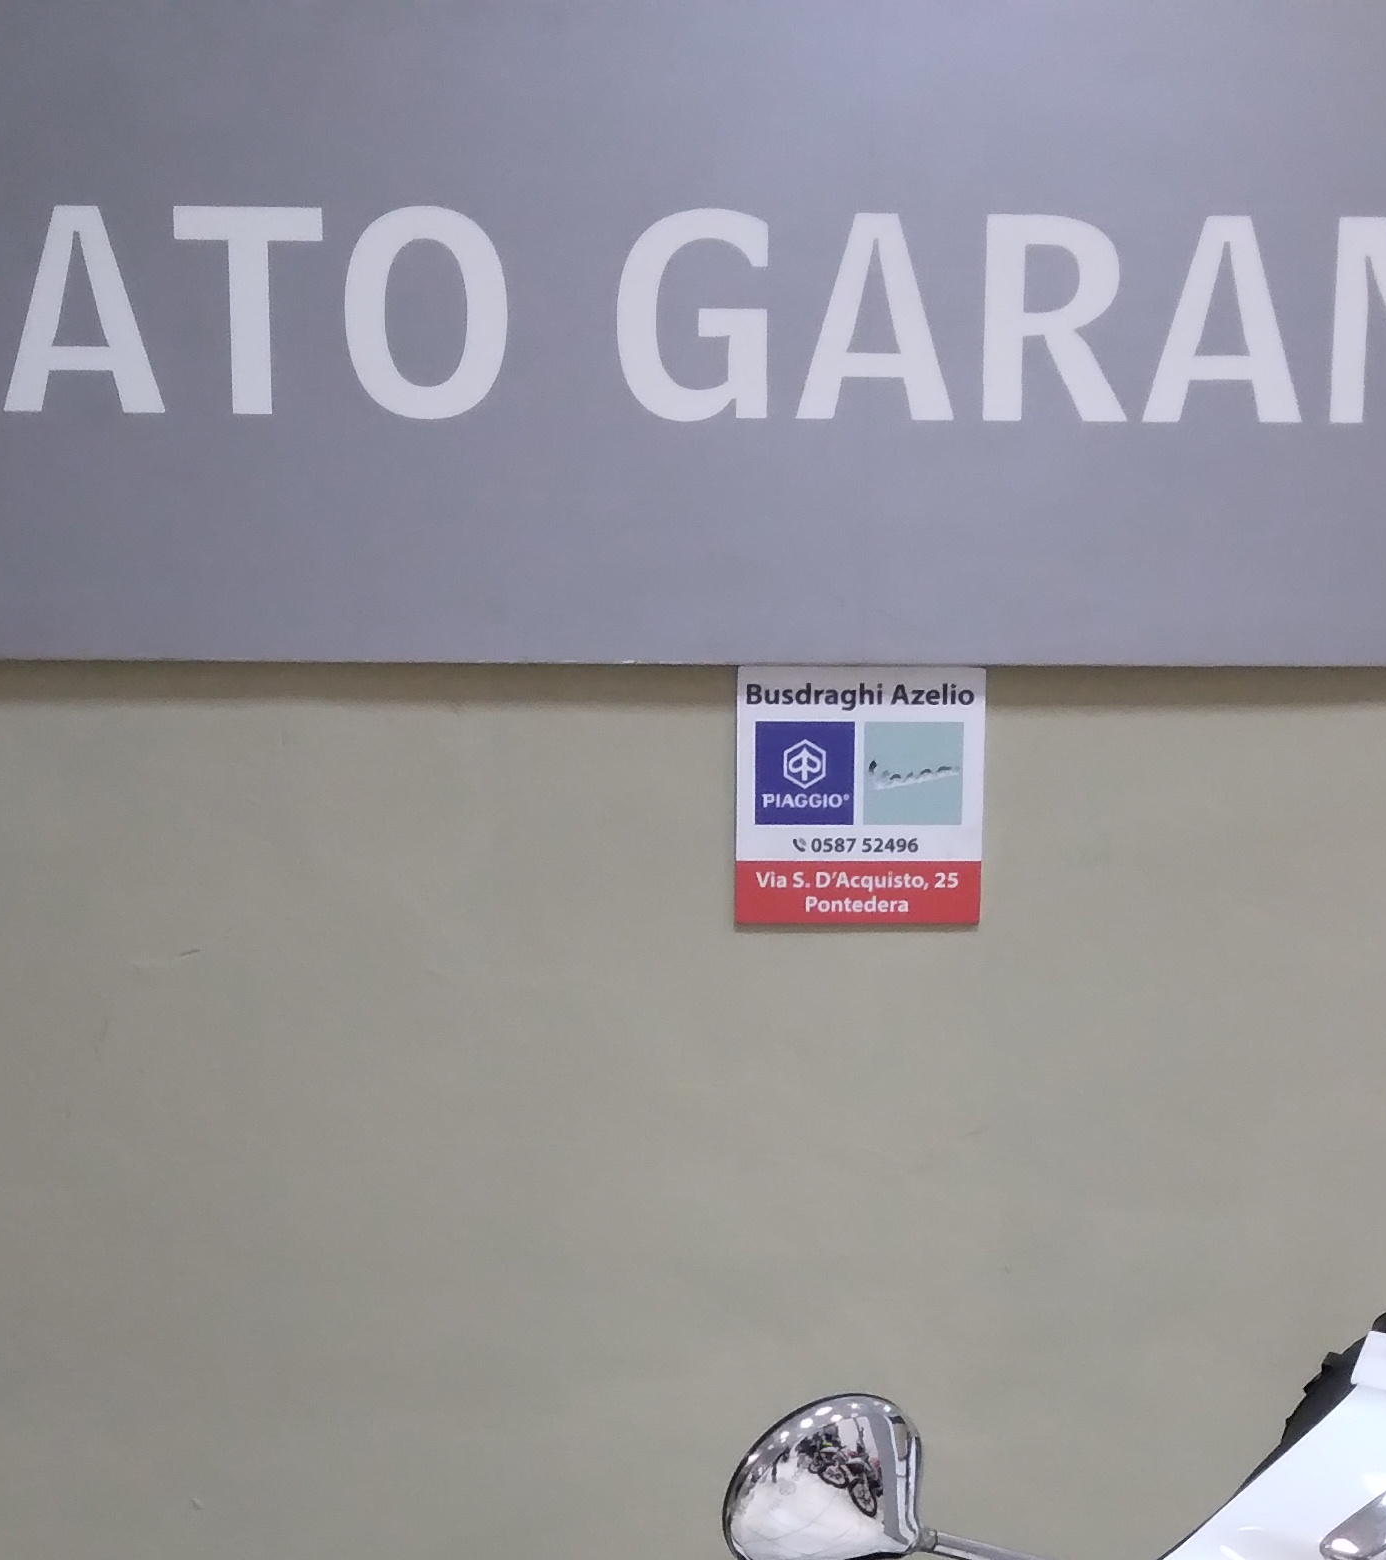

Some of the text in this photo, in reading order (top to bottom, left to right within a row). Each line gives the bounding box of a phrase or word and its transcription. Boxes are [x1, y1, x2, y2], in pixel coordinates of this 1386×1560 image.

[745, 683, 976, 711] Busdraghi Azelio
[810, 837, 919, 853] 0587 52496
[755, 871, 787, 889] Via
[792, 871, 811, 889] S.
[934, 872, 959, 889] 25
[804, 896, 909, 914] Pontedera
